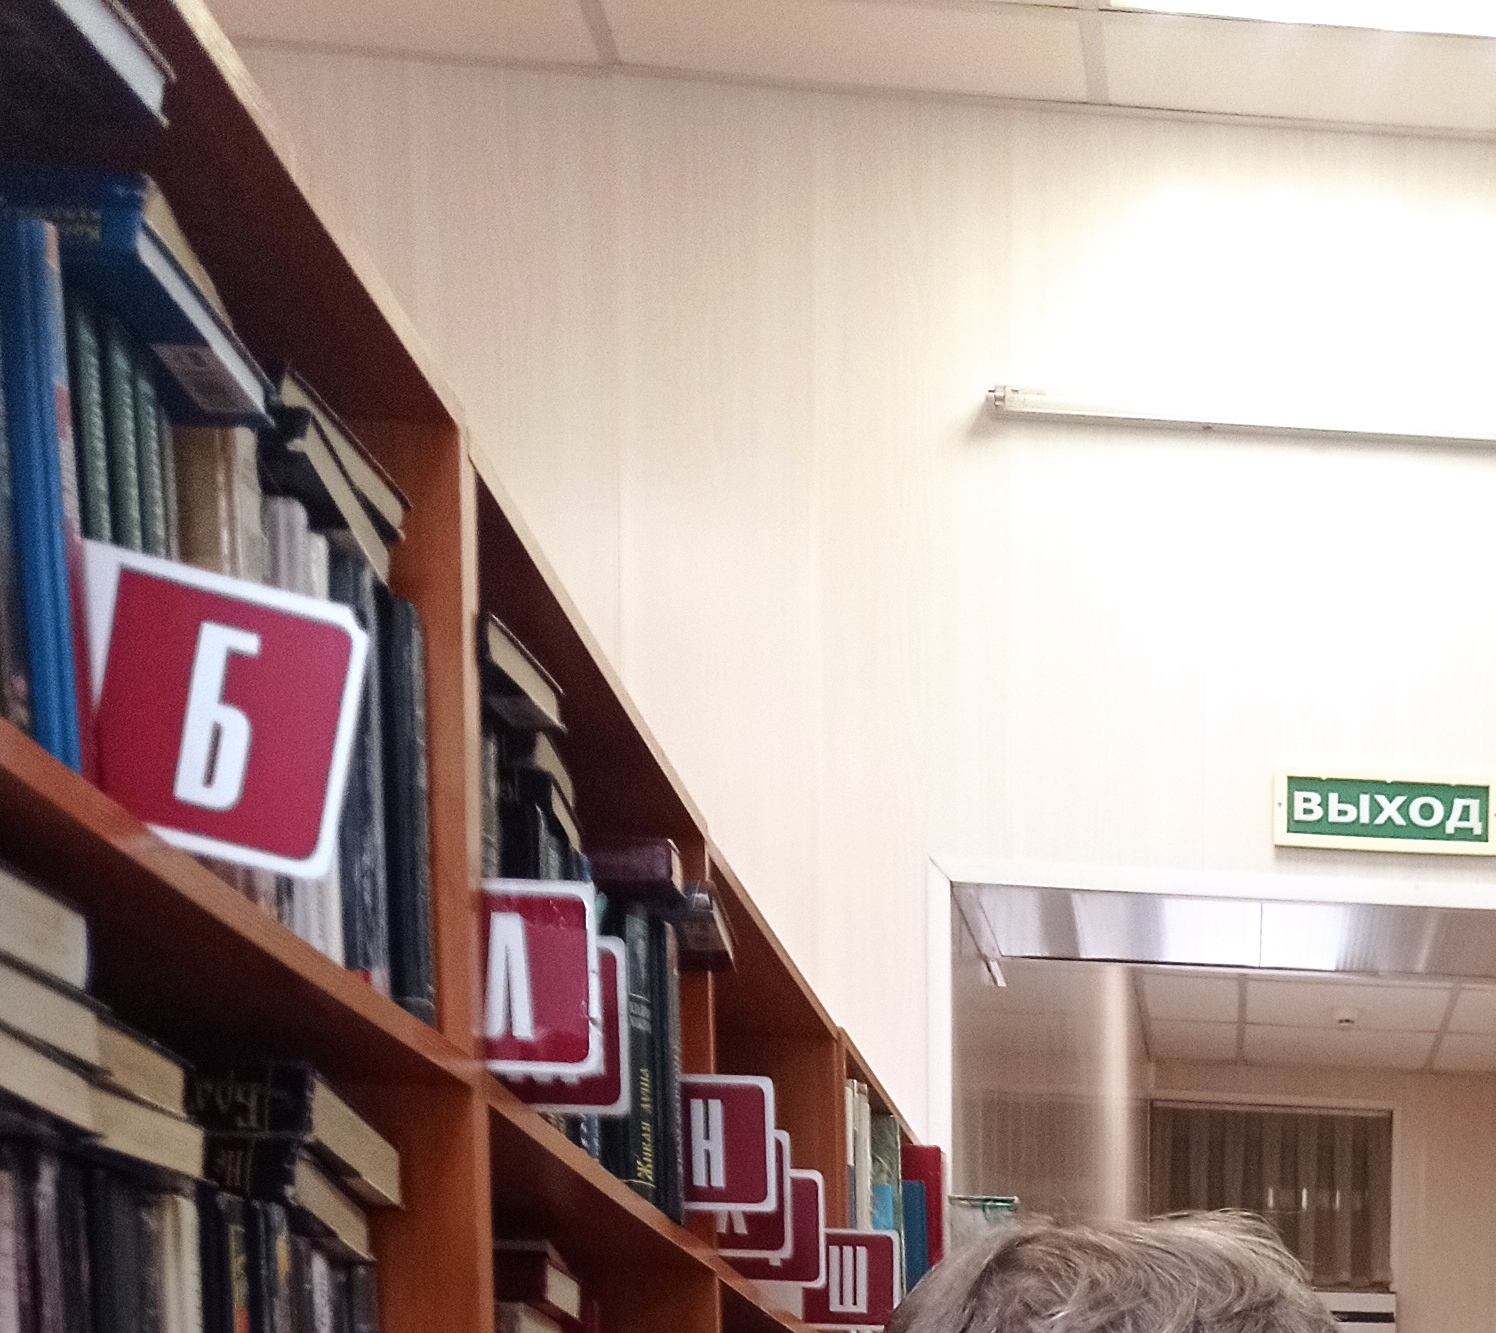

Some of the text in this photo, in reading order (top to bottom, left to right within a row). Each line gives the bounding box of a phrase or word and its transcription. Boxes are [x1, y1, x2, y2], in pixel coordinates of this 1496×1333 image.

[172, 620, 261, 813] Б
[1292, 790, 1482, 835] ВЫХОД
[487, 911, 534, 1040] Л
[690, 1098, 725, 1189] Н
[828, 1244, 868, 1314] Ш
